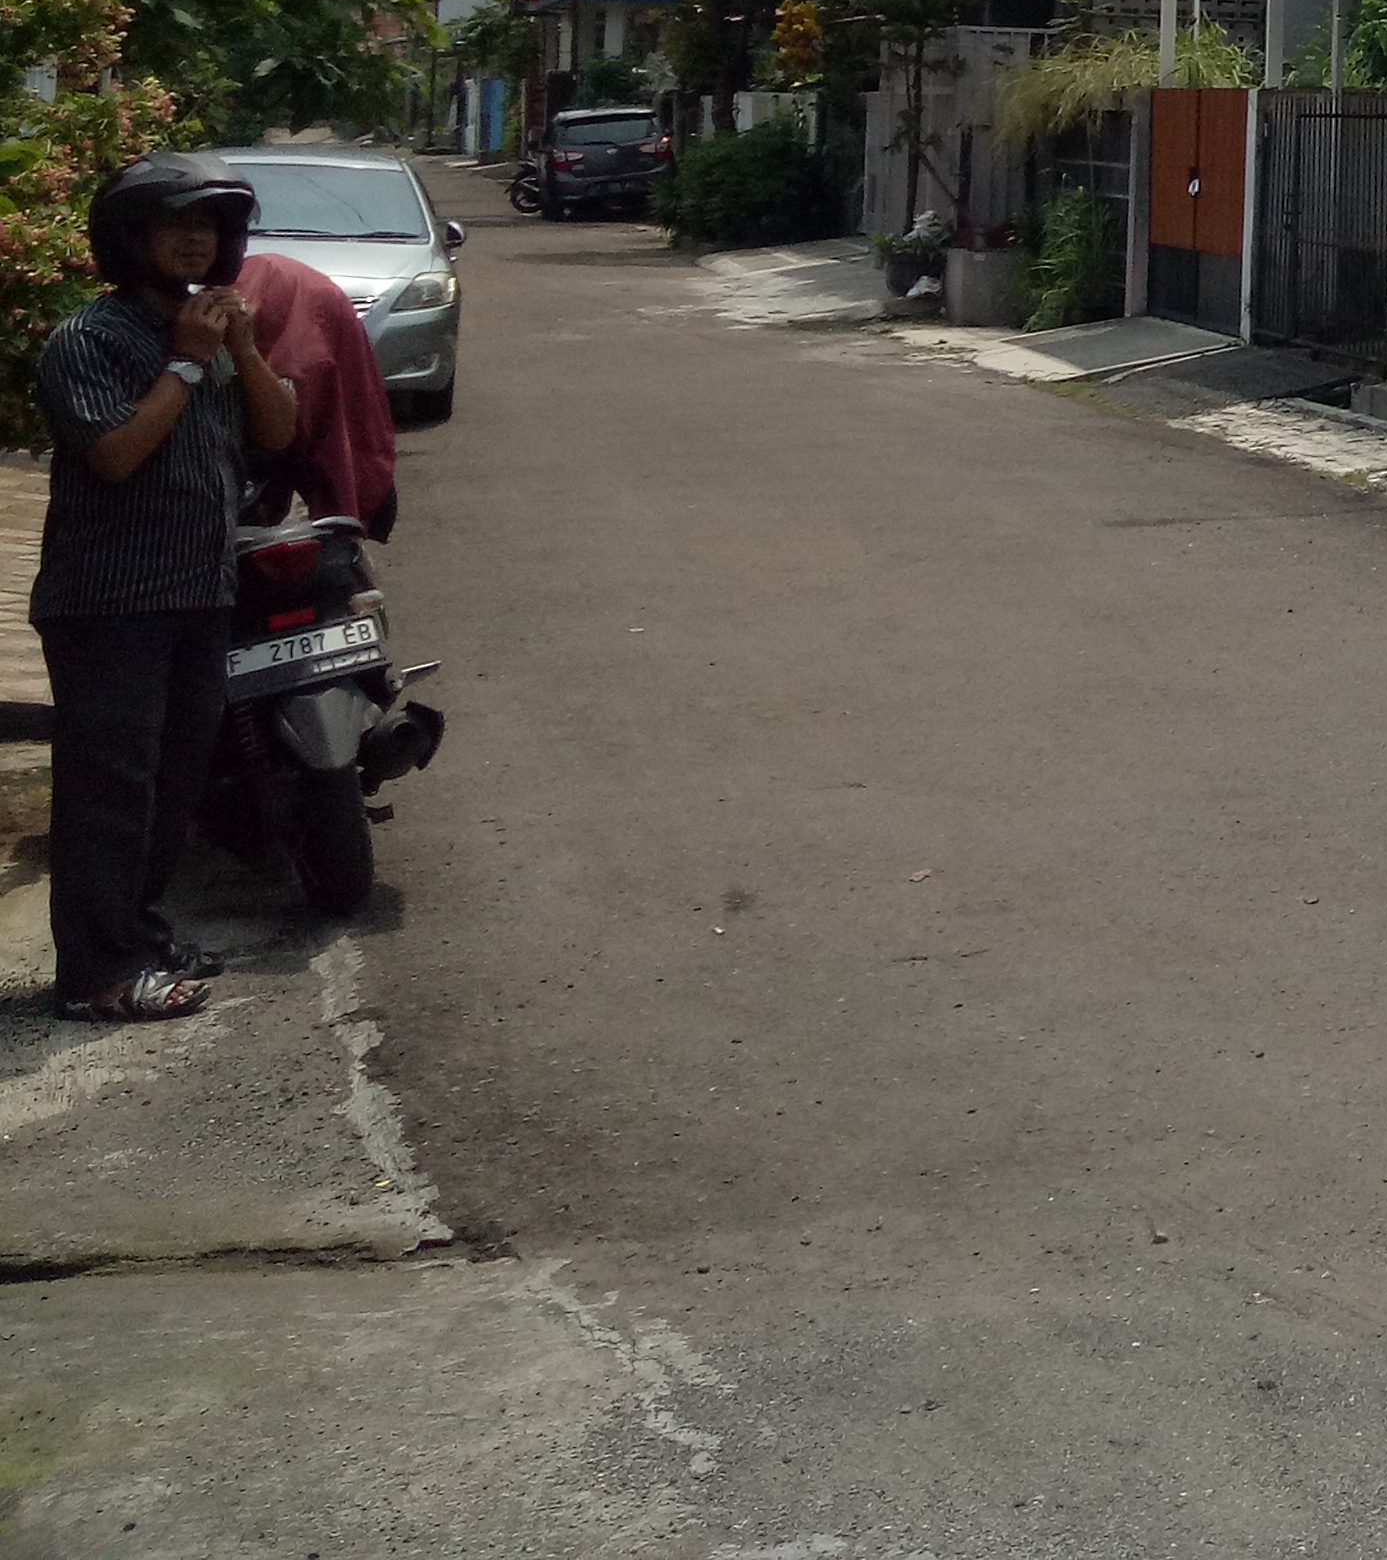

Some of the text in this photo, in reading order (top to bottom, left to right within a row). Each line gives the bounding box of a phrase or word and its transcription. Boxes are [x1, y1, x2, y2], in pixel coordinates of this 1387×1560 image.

[229, 623, 372, 673] F 2787 EB
